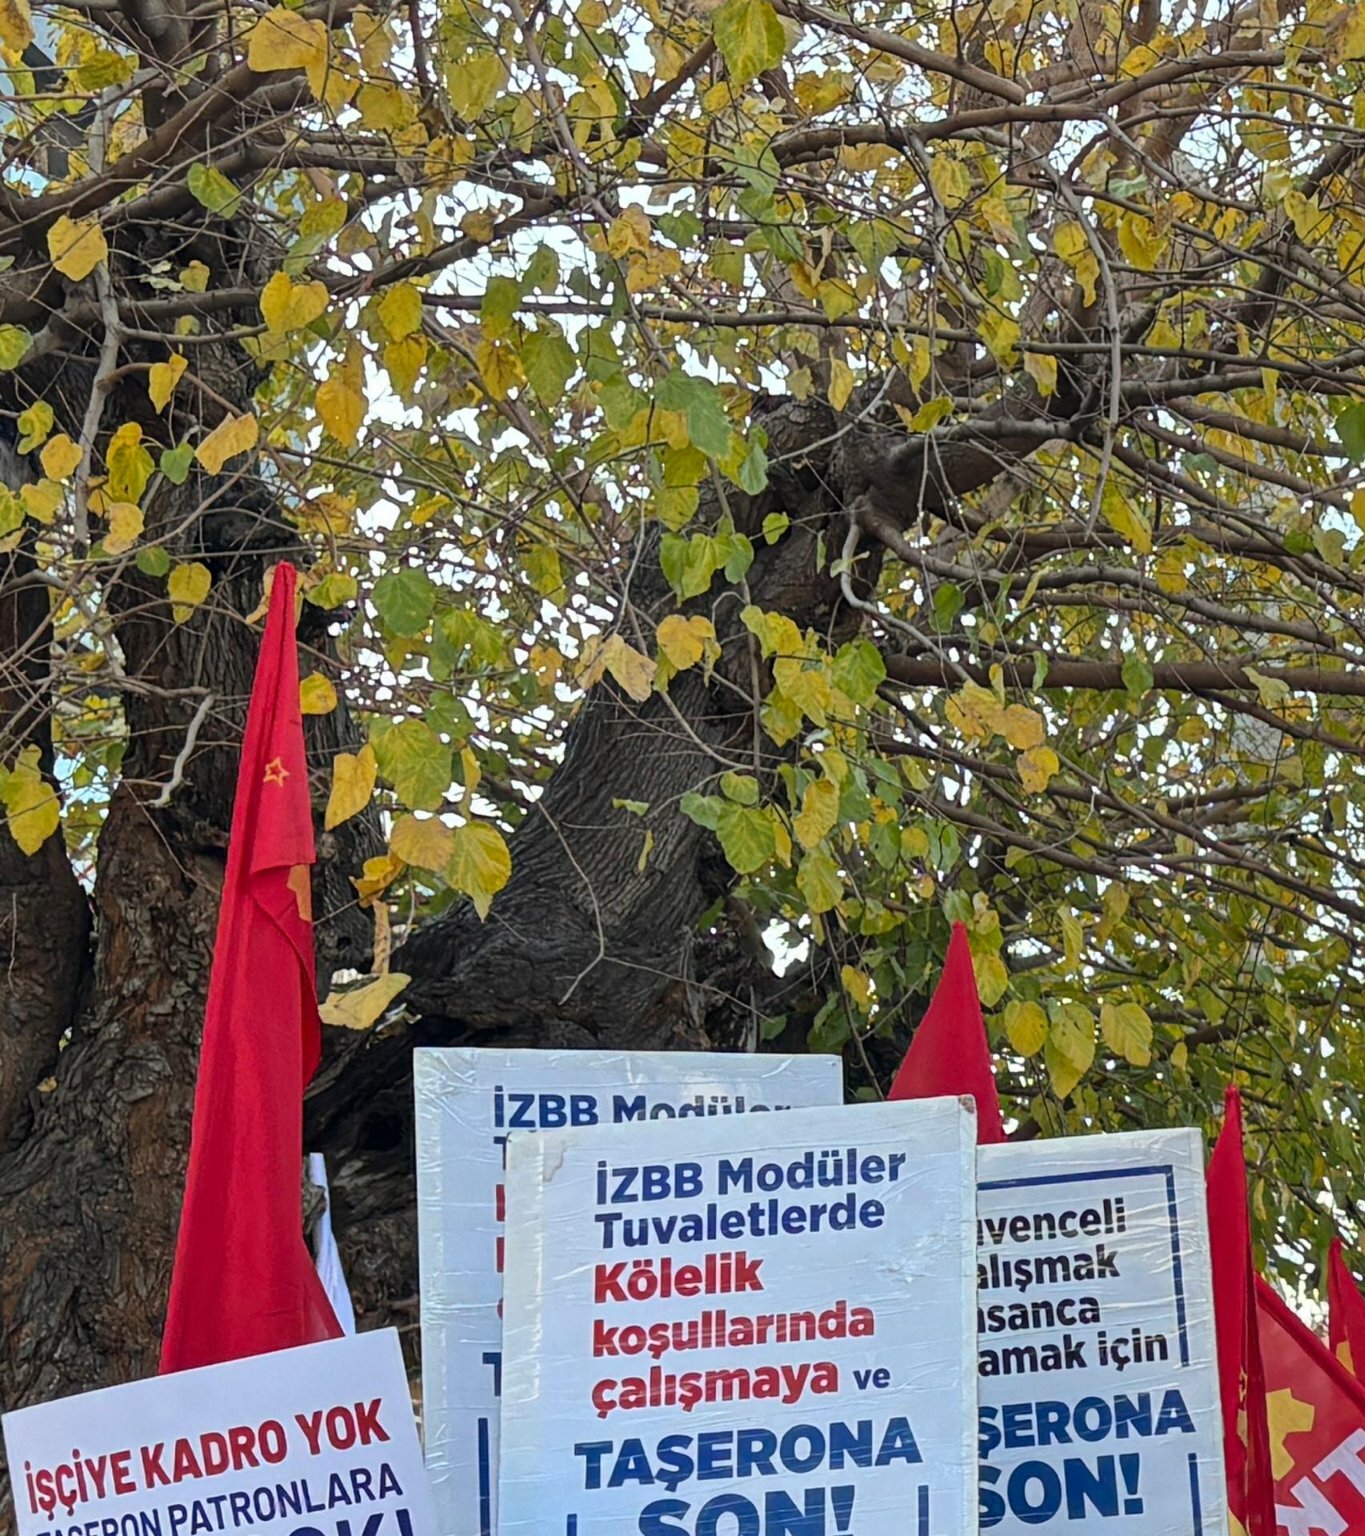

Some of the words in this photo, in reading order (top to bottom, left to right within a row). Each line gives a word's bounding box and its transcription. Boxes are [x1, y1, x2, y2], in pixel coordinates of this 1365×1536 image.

[494, 1085, 599, 1128] İZBB
[612, 1095, 792, 1122] Modül
[596, 1160, 703, 1205] İZBB
[718, 1148, 906, 1196] Modüler
[595, 1193, 886, 1249] Tuvaletlerde
[595, 1251, 764, 1304] Kölelik
[592, 1300, 875, 1361] koşullarında
[1098, 1327, 1168, 1371] için
[591, 1361, 839, 1419] çalışmaya
[853, 1363, 890, 1392] ve
[977, 1389, 1196, 1459] ŞERONA
[24, 1448, 137, 1521] İŞÇİYE
[140, 1420, 287, 1490] KADRO
[295, 1398, 391, 1456] YOK
[574, 1416, 923, 1493] TAŞERONA
[977, 1453, 1146, 1528] SON!
